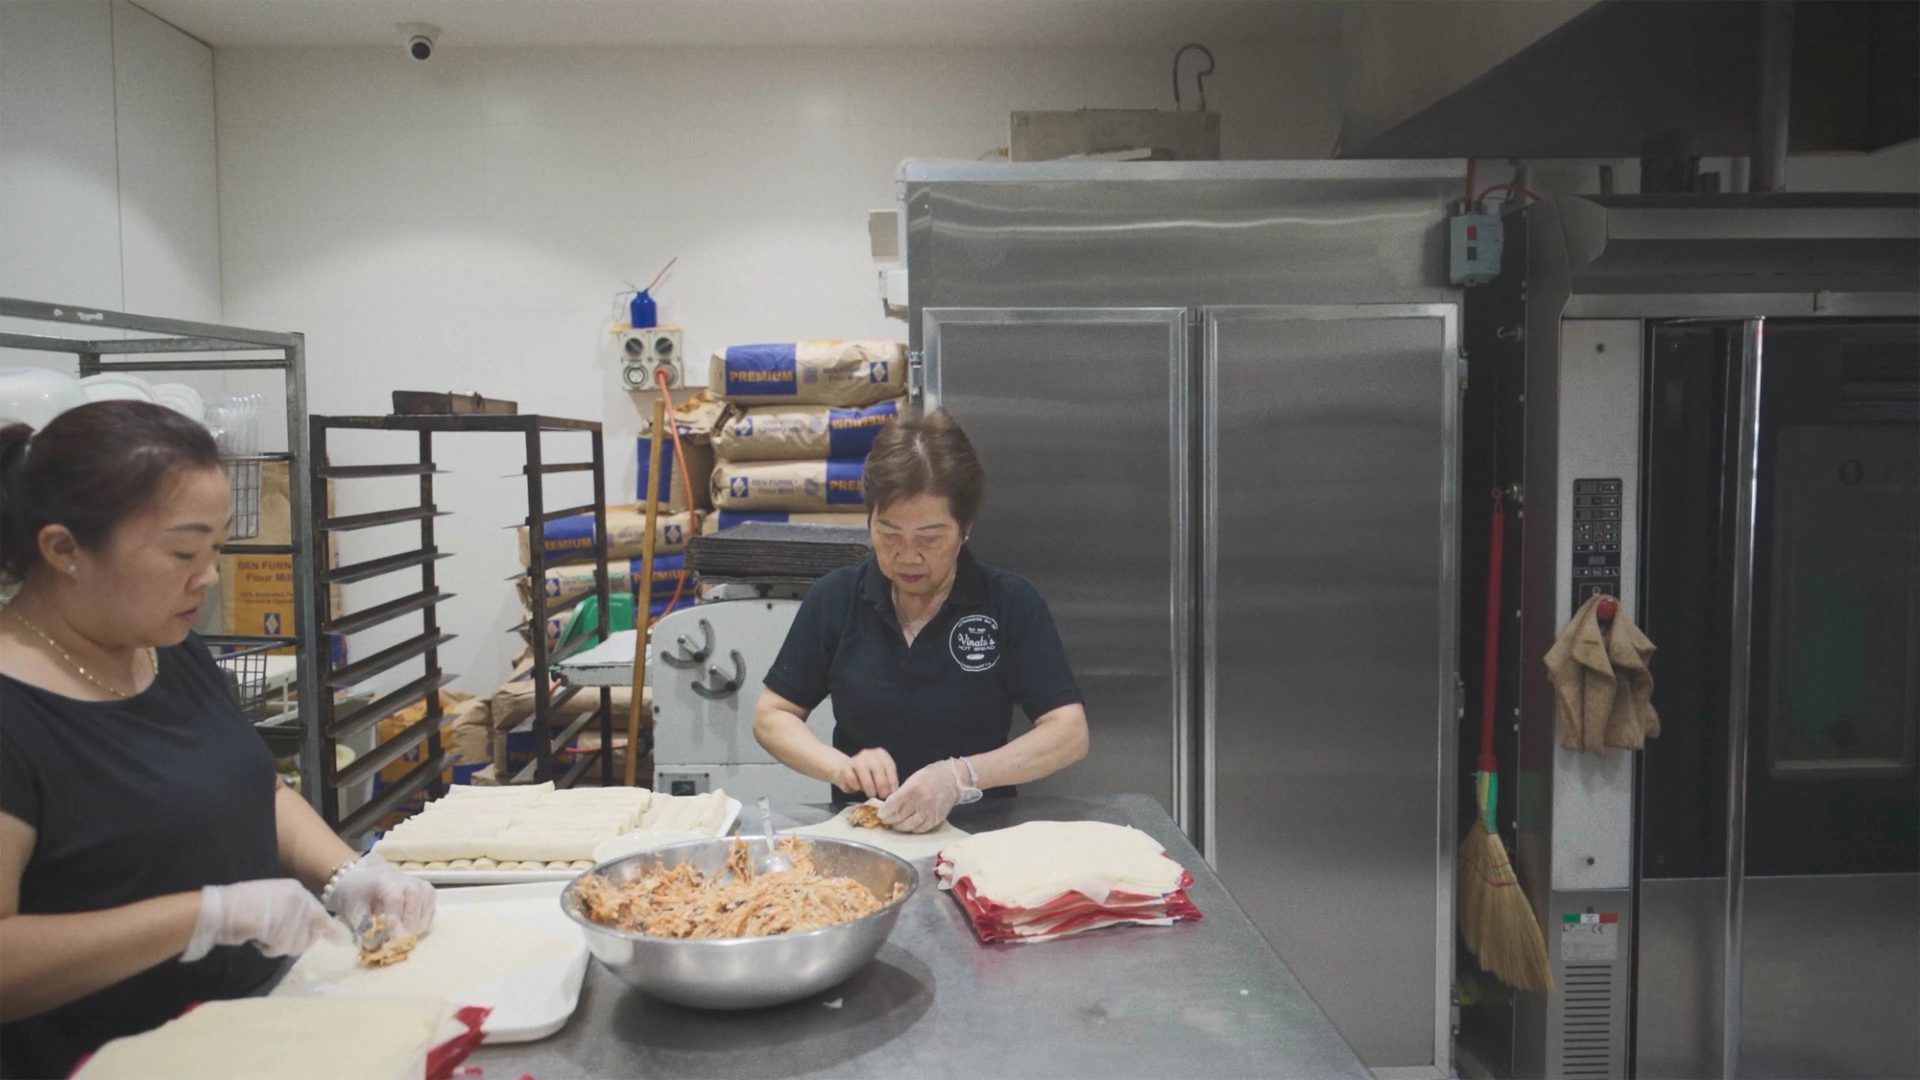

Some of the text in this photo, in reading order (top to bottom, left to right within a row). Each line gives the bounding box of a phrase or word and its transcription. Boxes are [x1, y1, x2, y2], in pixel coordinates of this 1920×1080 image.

[728, 370, 793, 382] PREMIUM
[238, 560, 259, 570] BEN
[246, 572, 273, 582] Flour
